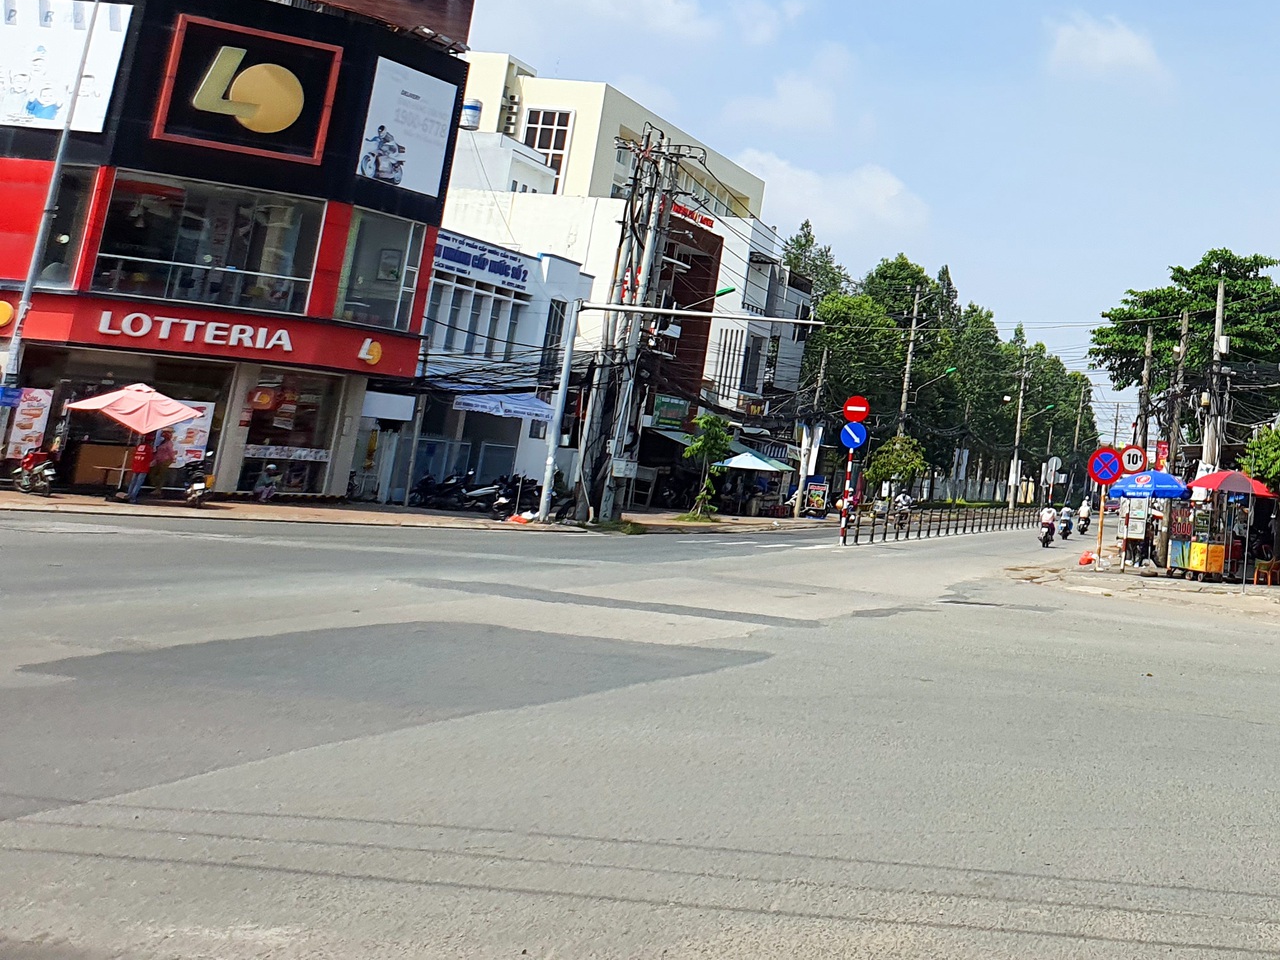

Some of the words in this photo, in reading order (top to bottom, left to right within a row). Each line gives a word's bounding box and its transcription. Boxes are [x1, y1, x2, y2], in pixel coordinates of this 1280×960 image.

[471, 253, 489, 271] CẤP
[488, 260, 512, 278] NƯỚC
[511, 264, 524, 281] SỐ
[521, 269, 529, 283] 2
[98, 310, 293, 352] LOTTERIA
